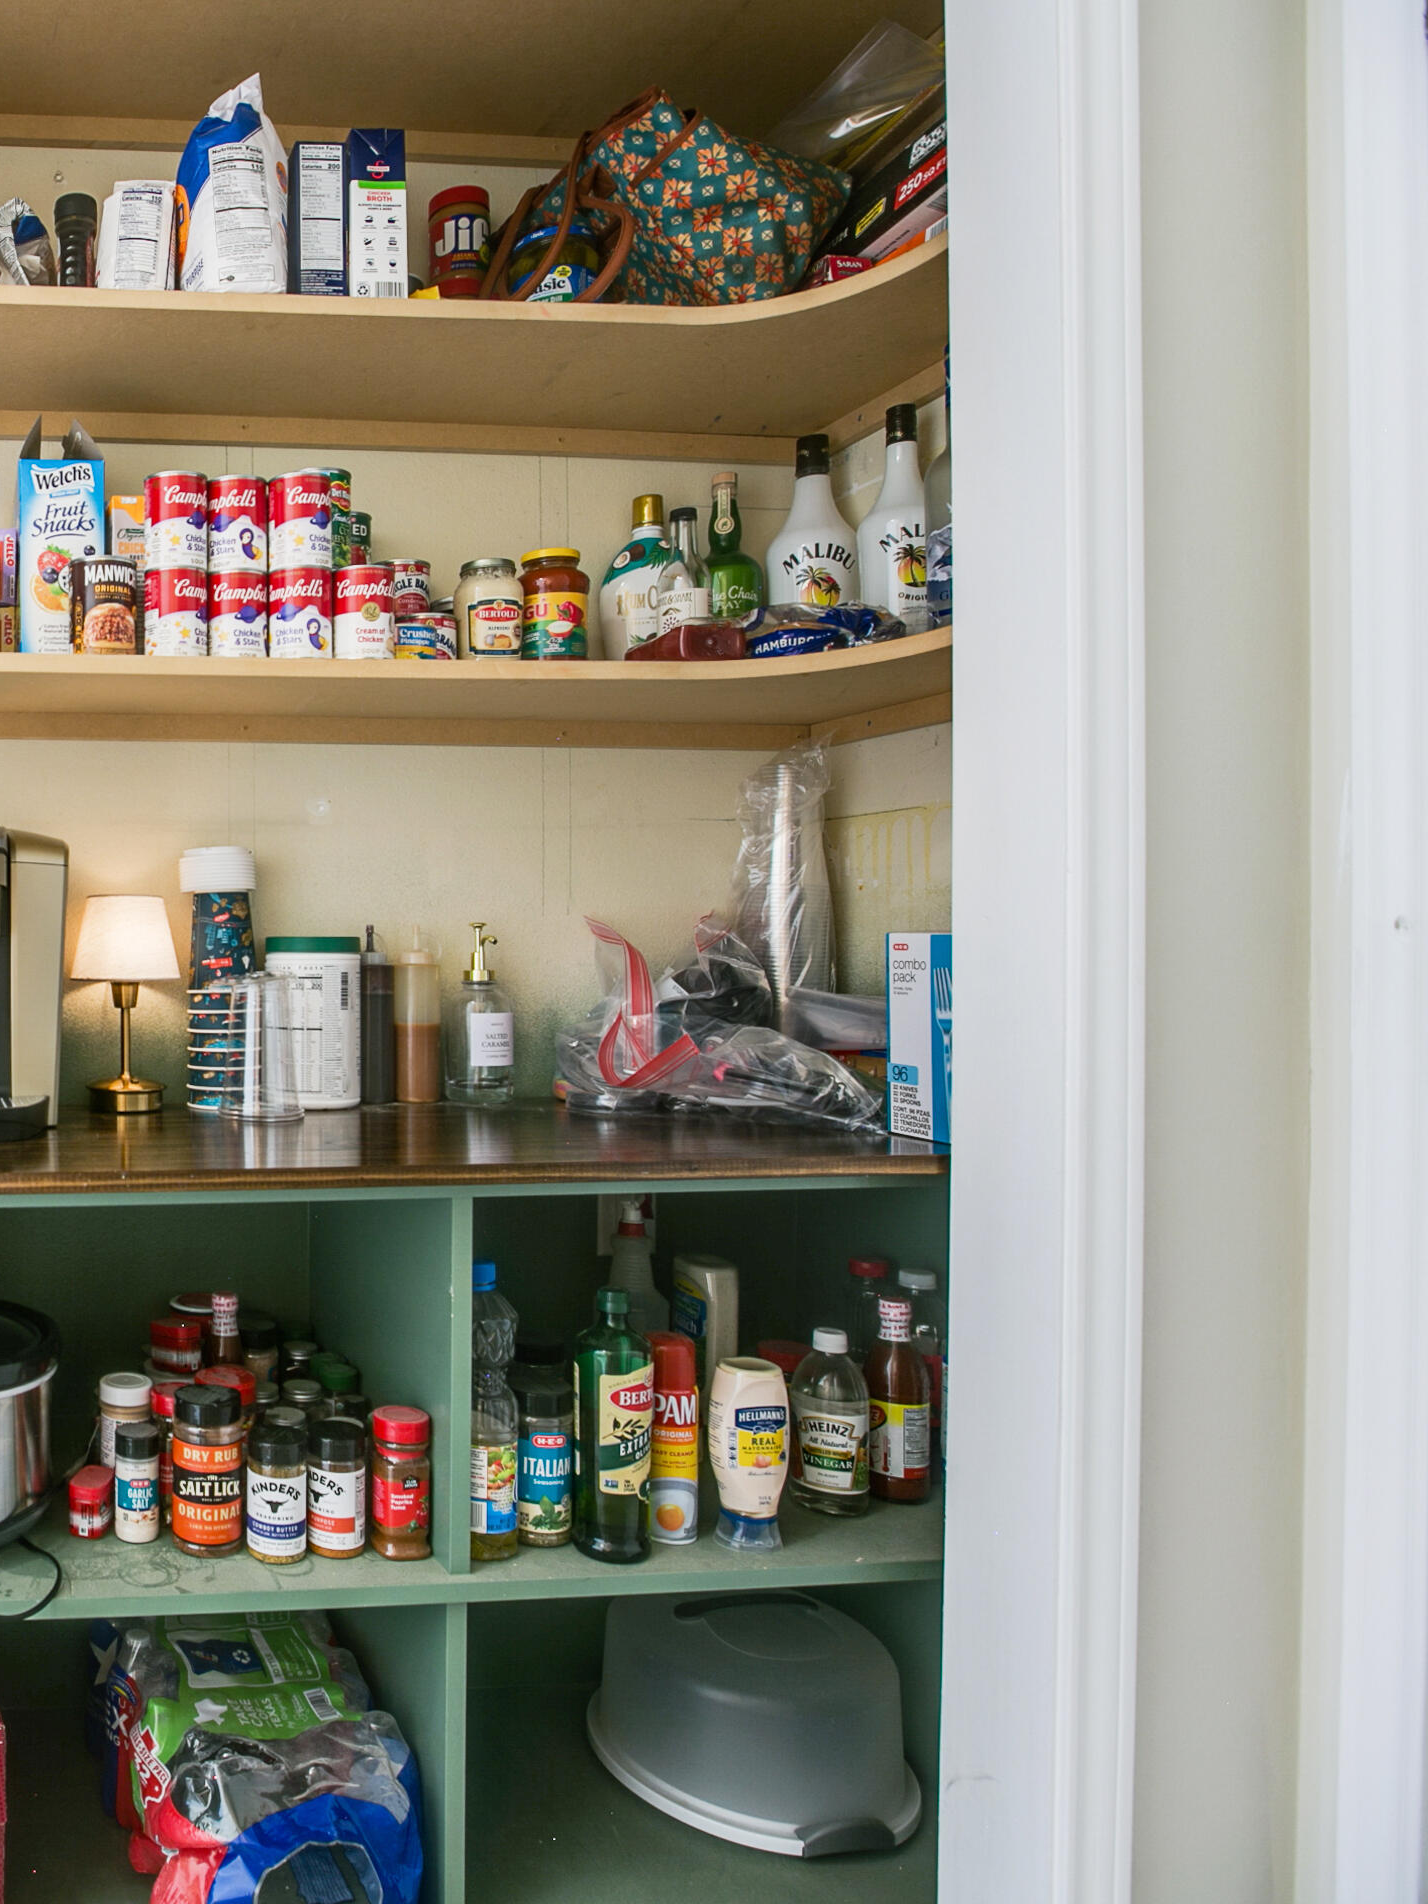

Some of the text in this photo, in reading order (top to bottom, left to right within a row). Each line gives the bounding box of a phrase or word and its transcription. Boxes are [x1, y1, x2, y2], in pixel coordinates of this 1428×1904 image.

[898, 172, 923, 202] 250
[836, 259, 863, 269] SARAN
[34, 465, 92, 490] Welch's
[208, 488, 257, 513] mpbell's
[286, 486, 331, 508] Campb
[44, 501, 90, 521] Fruit
[32, 516, 96, 537] Snacks
[878, 524, 925, 553] MAL
[782, 543, 856, 575] MALIBU
[84, 565, 136, 586] MANWIC
[95, 585, 131, 595] ORIGINAL
[728, 585, 758, 601] Chair
[479, 610, 518, 618] BERTOLLI
[523, 598, 549, 620] GÚ
[233, 629, 261, 638] Chicken
[275, 629, 304, 637] Chicken
[282, 636, 302, 645] Stars
[242, 638, 260, 646] Stars
[892, 959, 927, 971] combo
[892, 970, 917, 984] pack
[892, 1066, 908, 1082] 96
[899, 1085, 918, 1093] KNIVES
[899, 1091, 917, 1099] FORKS
[899, 1097, 921, 1107] SPOONS
[899, 1113, 930, 1124] CUCHILLOS
[899, 1119, 931, 1130] TENEDORES
[899, 1125, 929, 1136] CUCHARAS
[618, 1391, 653, 1406] BERT
[653, 1394, 697, 1425] PAM
[738, 1409, 785, 1422] HELLMANN'S
[653, 1430, 693, 1438] ORIGINAL
[808, 1420, 850, 1437] HEINZ
[619, 1434, 649, 1456] EXTRA
[751, 1437, 776, 1446] REAL
[820, 1438, 848, 1449] Natural
[183, 1447, 238, 1462] DRY RUB
[803, 1454, 853, 1470] VINEGAR
[523, 1457, 570, 1477] ITALIAN
[179, 1480, 240, 1496] SALT LICK
[251, 1482, 301, 1501] KINDER'S
[308, 1472, 344, 1496] NDER'S
[127, 1487, 153, 1499] GARLIC
[132, 1499, 149, 1509] SALT
[178, 1503, 240, 1522] ORIGINAL
[252, 1521, 298, 1534] COWBOY BUTTER
[152, 1764, 170, 1784] PACK
